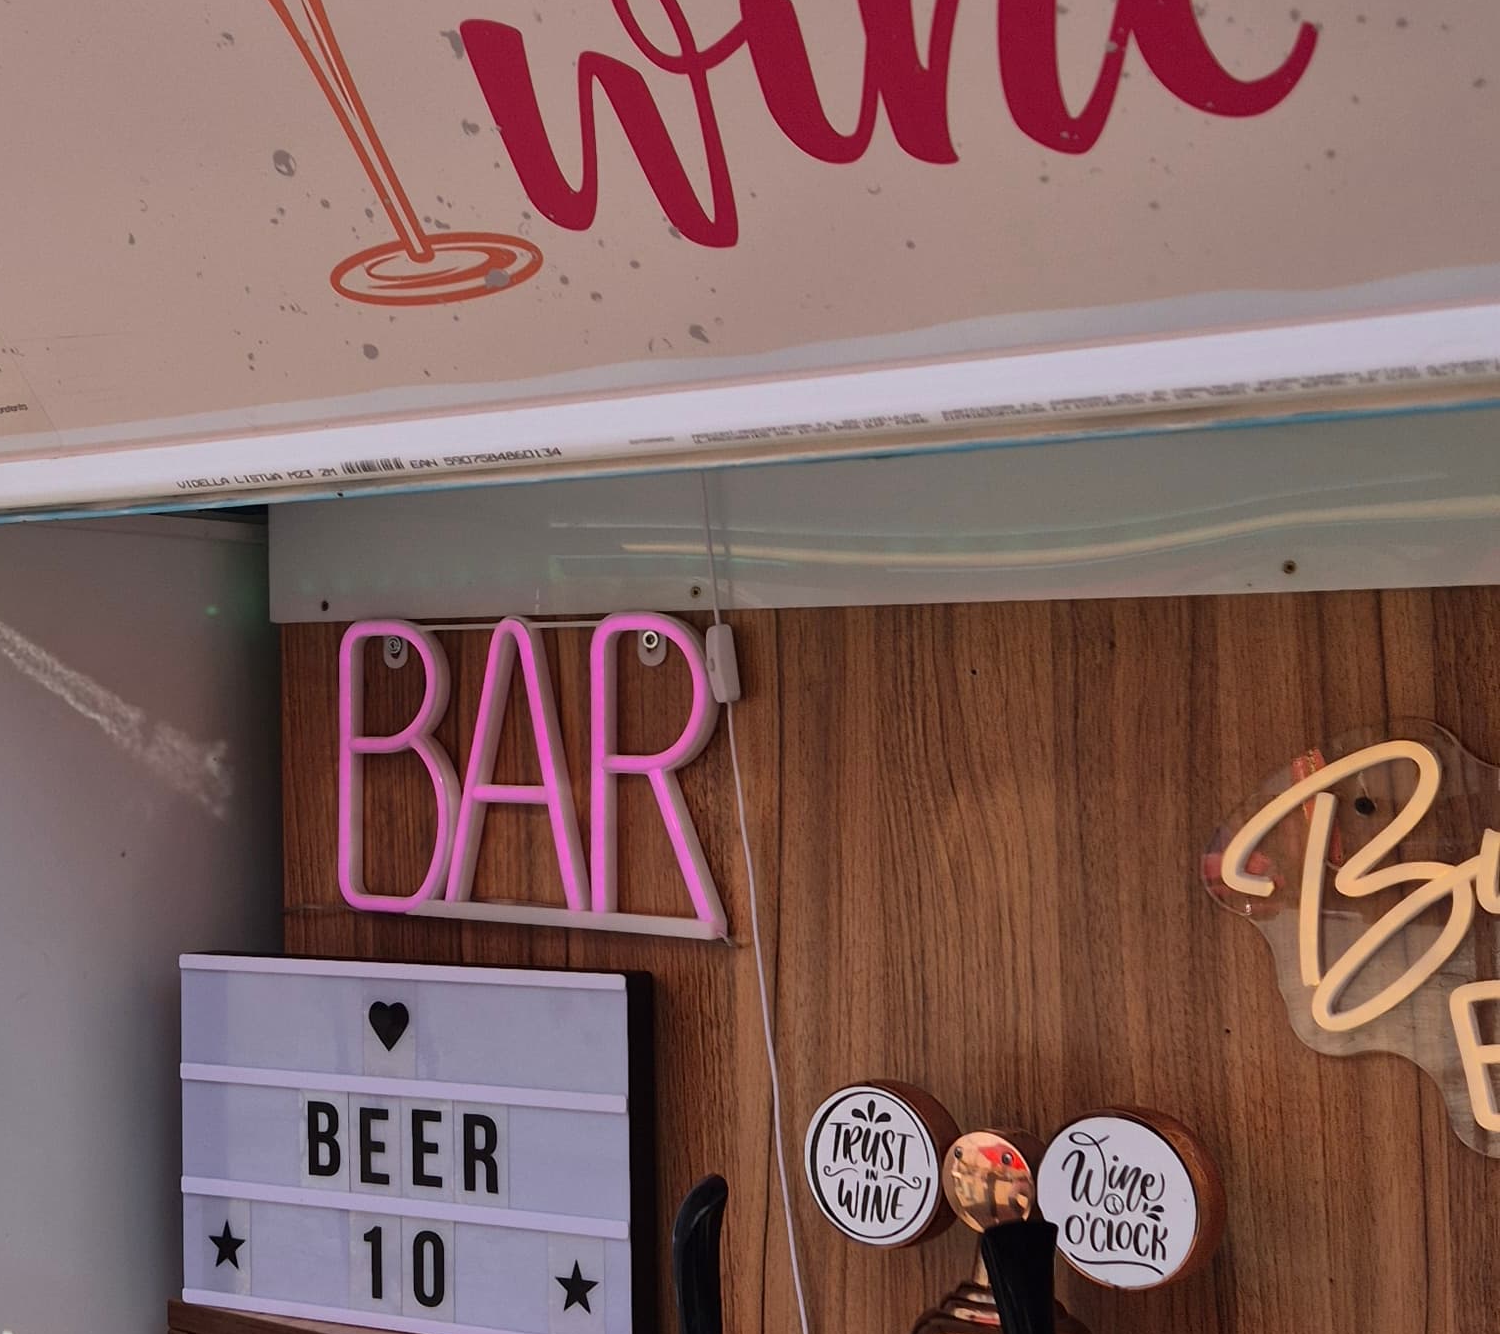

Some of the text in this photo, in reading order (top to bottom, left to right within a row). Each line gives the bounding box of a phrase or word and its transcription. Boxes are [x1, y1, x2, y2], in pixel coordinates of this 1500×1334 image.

[409, 458, 439, 470] EAN
[338, 611, 729, 941] BAR
[306, 1100, 502, 1196] BEER
[830, 1121, 915, 1176] TRUST
[865, 1169, 879, 1182] IN
[1061, 1131, 1166, 1213] Wine
[836, 1180, 906, 1225] WINE
[1065, 1213, 1169, 1262] O'CLOCK
[362, 1224, 446, 1309] 10
